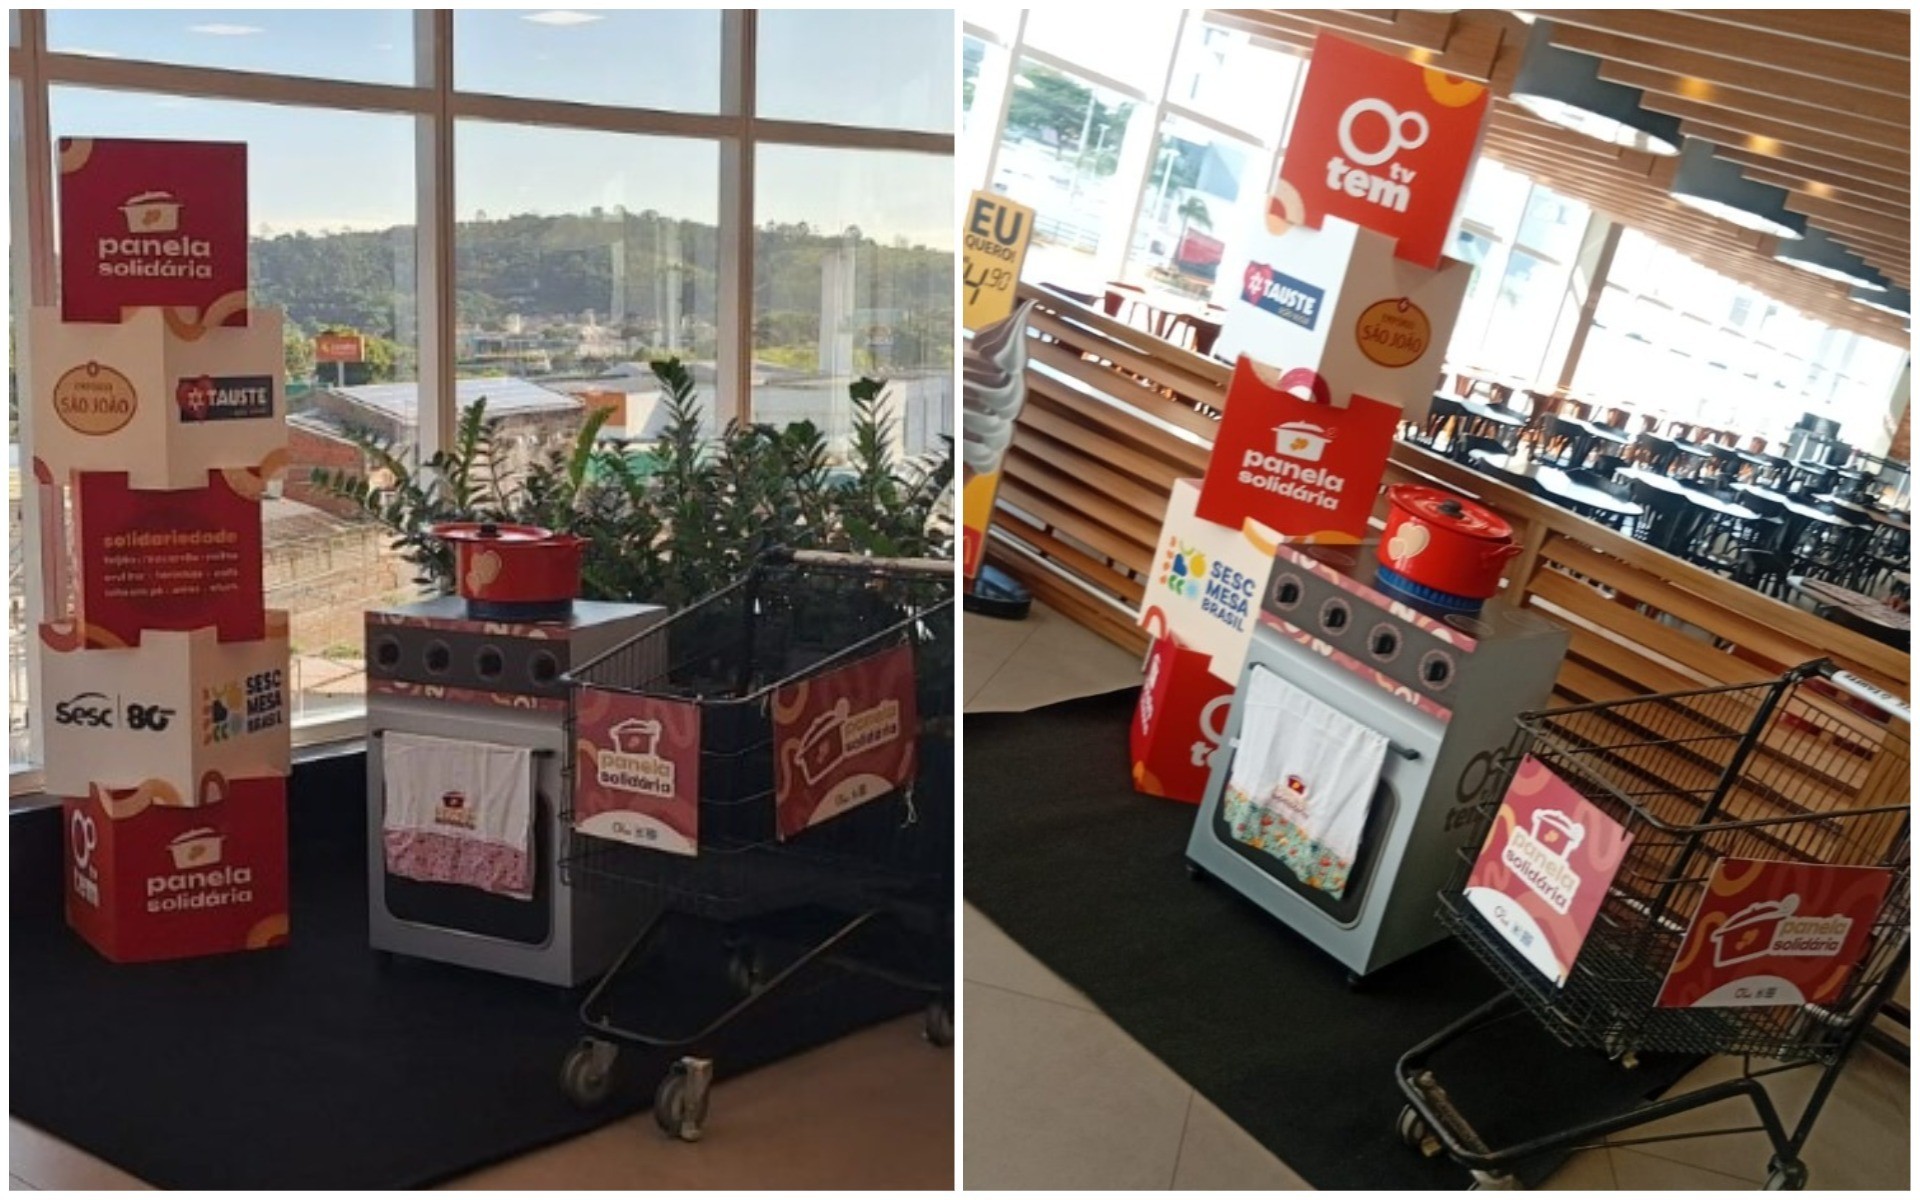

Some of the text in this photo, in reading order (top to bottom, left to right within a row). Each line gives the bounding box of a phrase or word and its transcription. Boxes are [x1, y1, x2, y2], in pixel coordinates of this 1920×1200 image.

[1326, 156, 1410, 213] tem
[1390, 162, 1417, 183] tv
[970, 197, 1023, 246] EU
[99, 236, 211, 259] panela
[965, 234, 1016, 263] QUERO!
[99, 259, 213, 279] solidária
[1262, 280, 1316, 316] TAUSTE
[1363, 324, 1421, 353] SÃO JOÃO
[61, 395, 129, 414] SÃO JOÃO
[207, 387, 267, 407] TAUSTE
[1242, 449, 1344, 493] panela
[1238, 470, 1339, 511] solidária
[1210, 561, 1256, 597] SESC
[1205, 579, 1248, 617] MESA
[1201, 597, 1244, 632] BRASIL
[246, 669, 281, 694] SESC
[56, 702, 112, 727] Sesc
[246, 690, 282, 716] MESA
[246, 711, 283, 733] BRASIL
[602, 754, 671, 778] panela
[601, 771, 670, 793] solidária
[147, 864, 252, 897] panela
[1505, 849, 1566, 909] solidária
[147, 887, 254, 913] solidária
[1773, 936, 1839, 951] solidária
